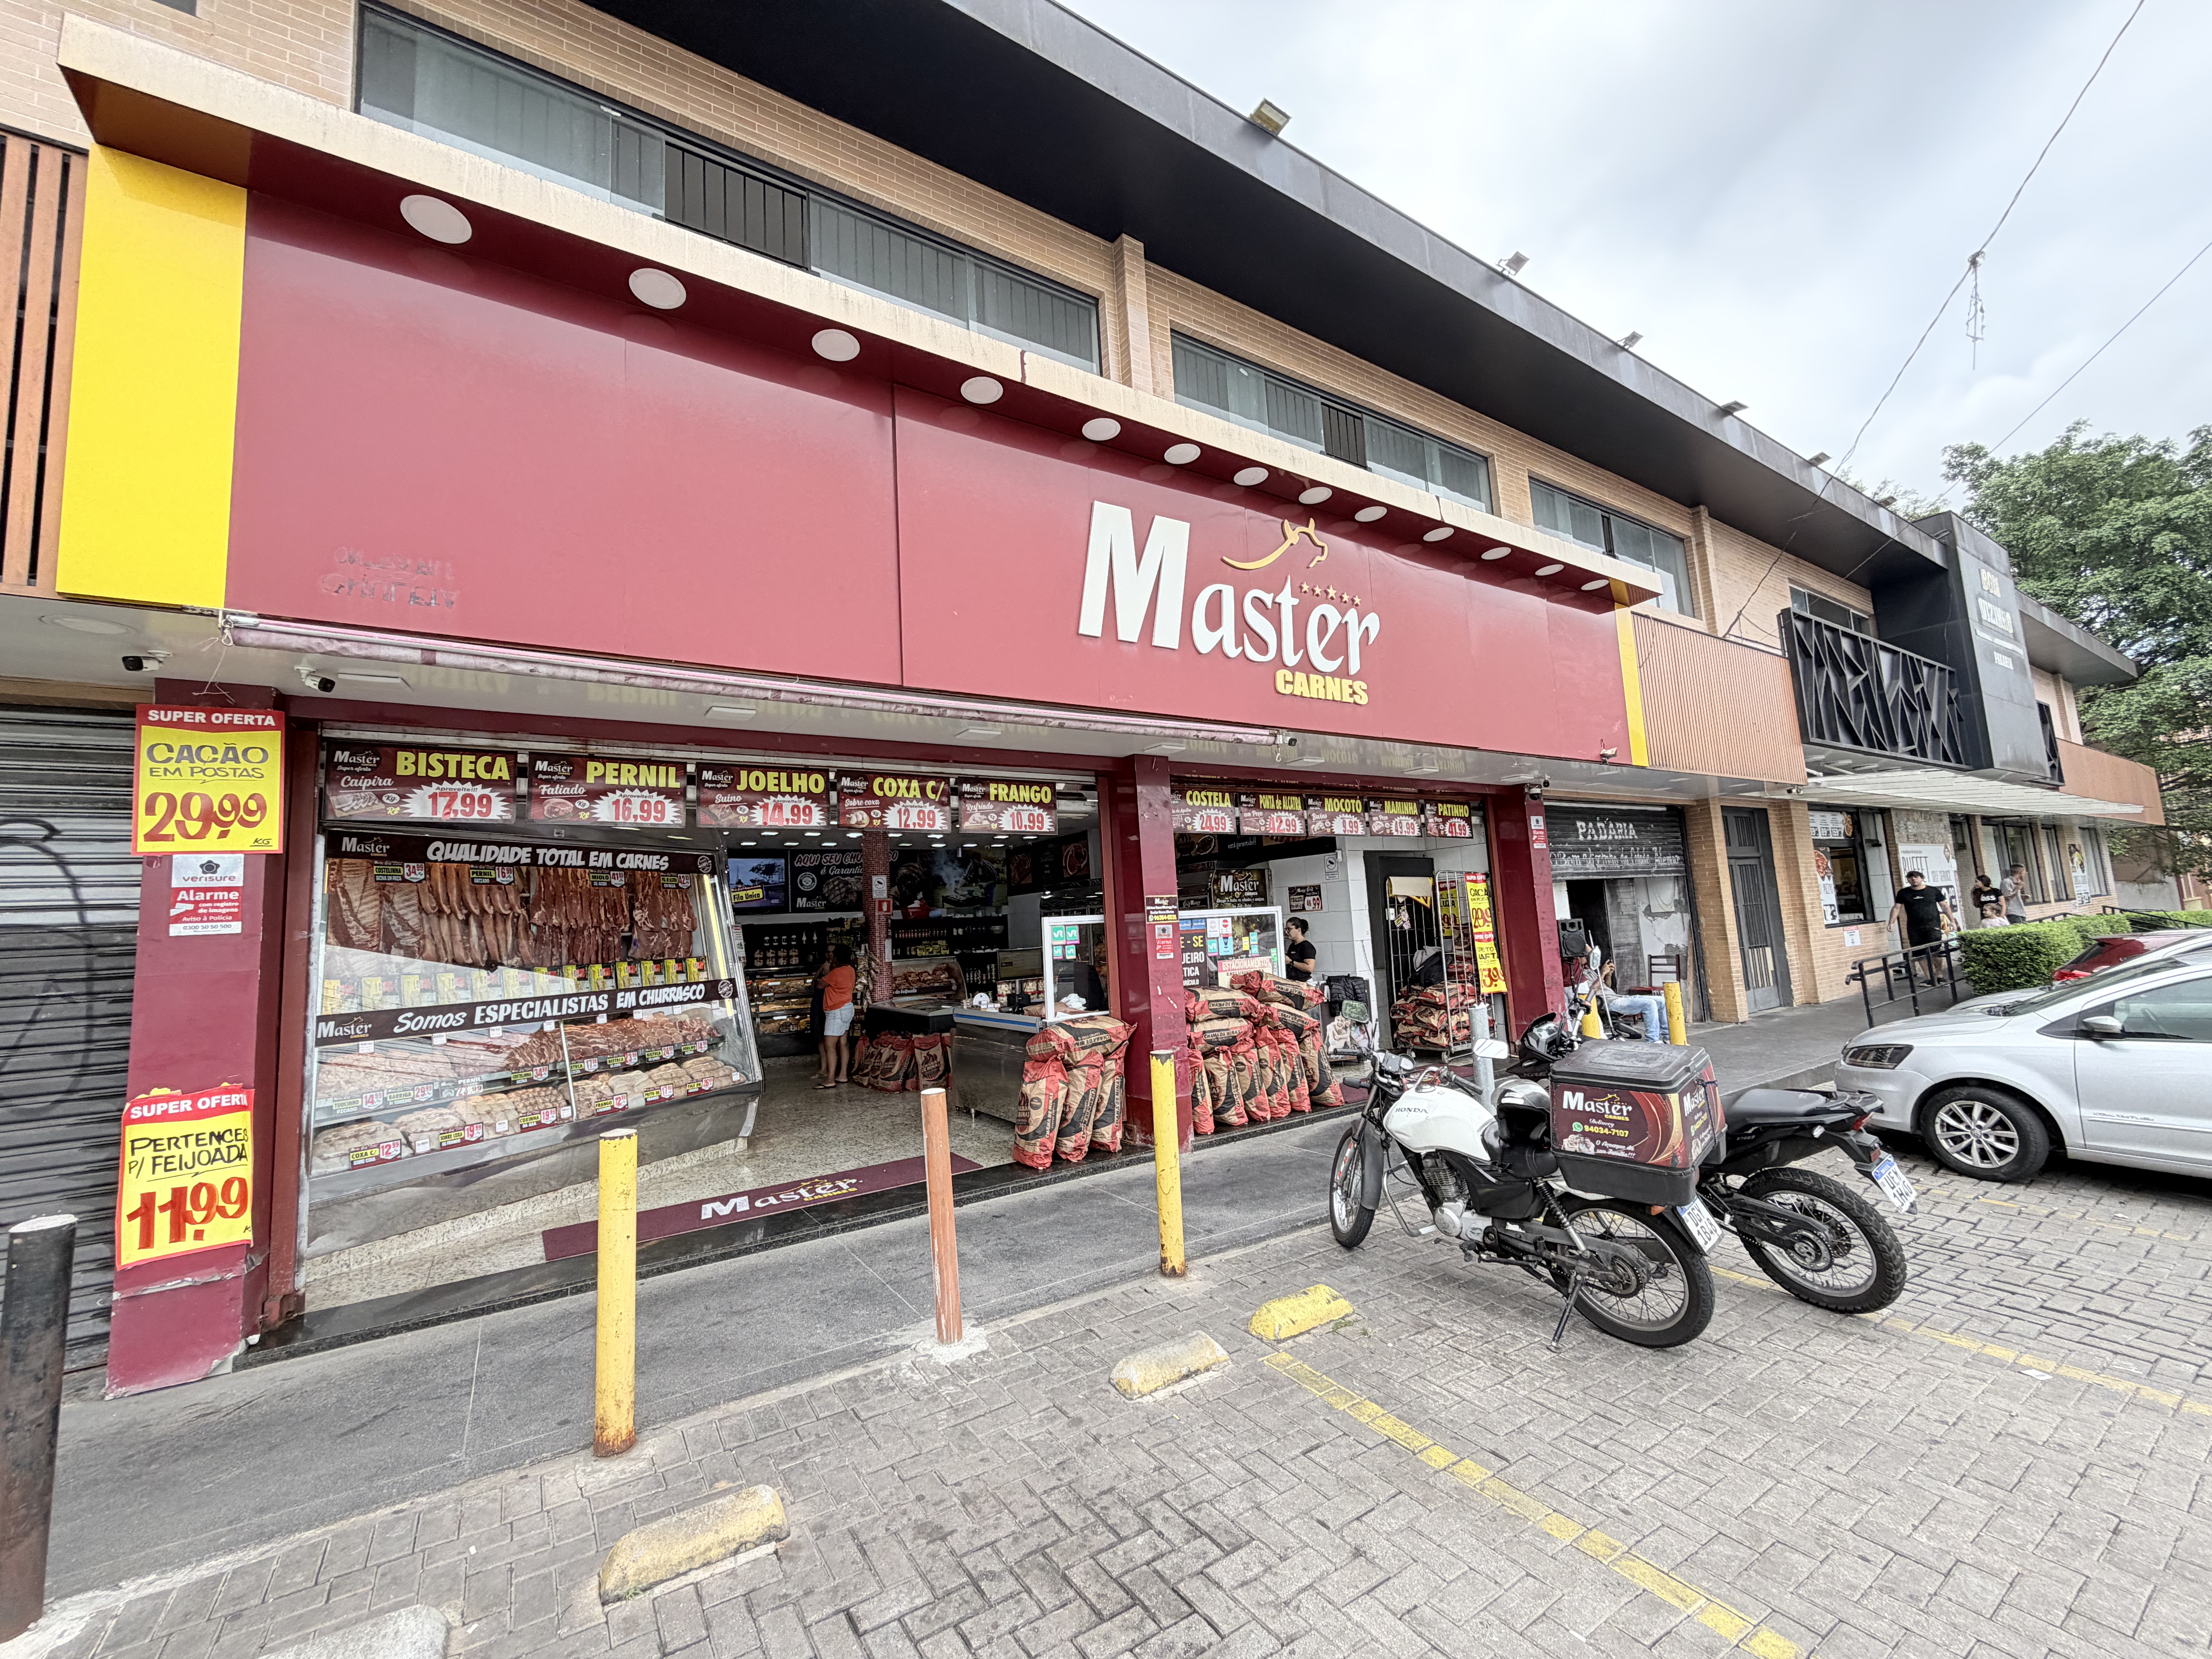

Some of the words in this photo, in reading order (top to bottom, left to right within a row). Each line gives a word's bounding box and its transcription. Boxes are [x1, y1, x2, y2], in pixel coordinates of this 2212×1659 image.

[1079, 500, 1380, 676] Master
[1275, 669, 1369, 705] CARNES
[148, 710, 207, 723] SUPER
[211, 713, 276, 726] OFERTA
[146, 742, 269, 765] CAÇÃO
[334, 750, 380, 765] Master
[149, 767, 182, 778] EM
[189, 767, 265, 779] POSTAS
[396, 751, 510, 780] BISTECA
[535, 761, 573, 773] Master
[340, 775, 394, 790] Caipira
[586, 761, 680, 788] PERNIL
[702, 770, 733, 781] Master
[736, 770, 824, 793] JOELHO
[841, 777, 869, 788] Master
[539, 784, 586, 795] Fatiado
[873, 777, 921, 799] COXA
[926, 780, 945, 801] C/
[962, 783, 986, 793] Master
[989, 783, 1051, 803] FRANGO
[428, 792, 492, 819] 17,99
[715, 793, 743, 804] Suíno
[845, 799, 864, 807] Sobre
[1186, 790, 1231, 808] COSTELA
[1259, 795, 1275, 809] PONTA
[1276, 794, 1282, 810] de
[1283, 796, 1302, 811] ALCATRA
[1324, 795, 1362, 813] MOCOTÓ
[612, 798, 666, 822] 16,99
[1384, 800, 1418, 815] MAMINHA
[1438, 803, 1469, 817] PATINHO
[143, 792, 267, 842] 29,99
[897, 807, 936, 828] 12,99
[1010, 812, 1044, 830] 10,99
[1575, 821, 1638, 840] PADARIA
[341, 837, 390, 854] Master
[426, 841, 532, 864] QUALIDADE
[536, 848, 586, 867] TOTAL
[589, 851, 613, 869] EM
[616, 852, 669, 871] CARNES
[794, 854, 820, 867] AQUI
[822, 853, 842, 866] SEU
[1221, 875, 1259, 892] Master
[177, 890, 239, 901] Alarme
[733, 893, 744, 902] Fila
[745, 891, 760, 900] Única
[797, 897, 826, 908] Master
[1193, 936, 1204, 947] SE
[1183, 966, 1199, 977] TICA
[317, 1021, 372, 1039] Master
[393, 1012, 467, 1033] Somos
[474, 994, 609, 1025] ESPECIALISTAS
[616, 989, 637, 1009] EM
[639, 984, 706, 1007] CHURRASCO
[130, 1099, 193, 1119] SUPER
[1563, 1091, 1632, 1116] Master
[1584, 1125, 1629, 1137] 94034-7107
[1589, 1118, 1614, 1128] Delivery
[129, 1128, 249, 1156] PERTENCES
[129, 1157, 144, 1179] P/
[151, 1144, 248, 1175] FEIJOADA
[352, 1151, 368, 1159] COXA
[701, 1178, 863, 1220] Master
[803, 1187, 858, 1201] CARNES
[1687, 1203, 1705, 1228] DGY
[1697, 1218, 1717, 1245] 1B48
